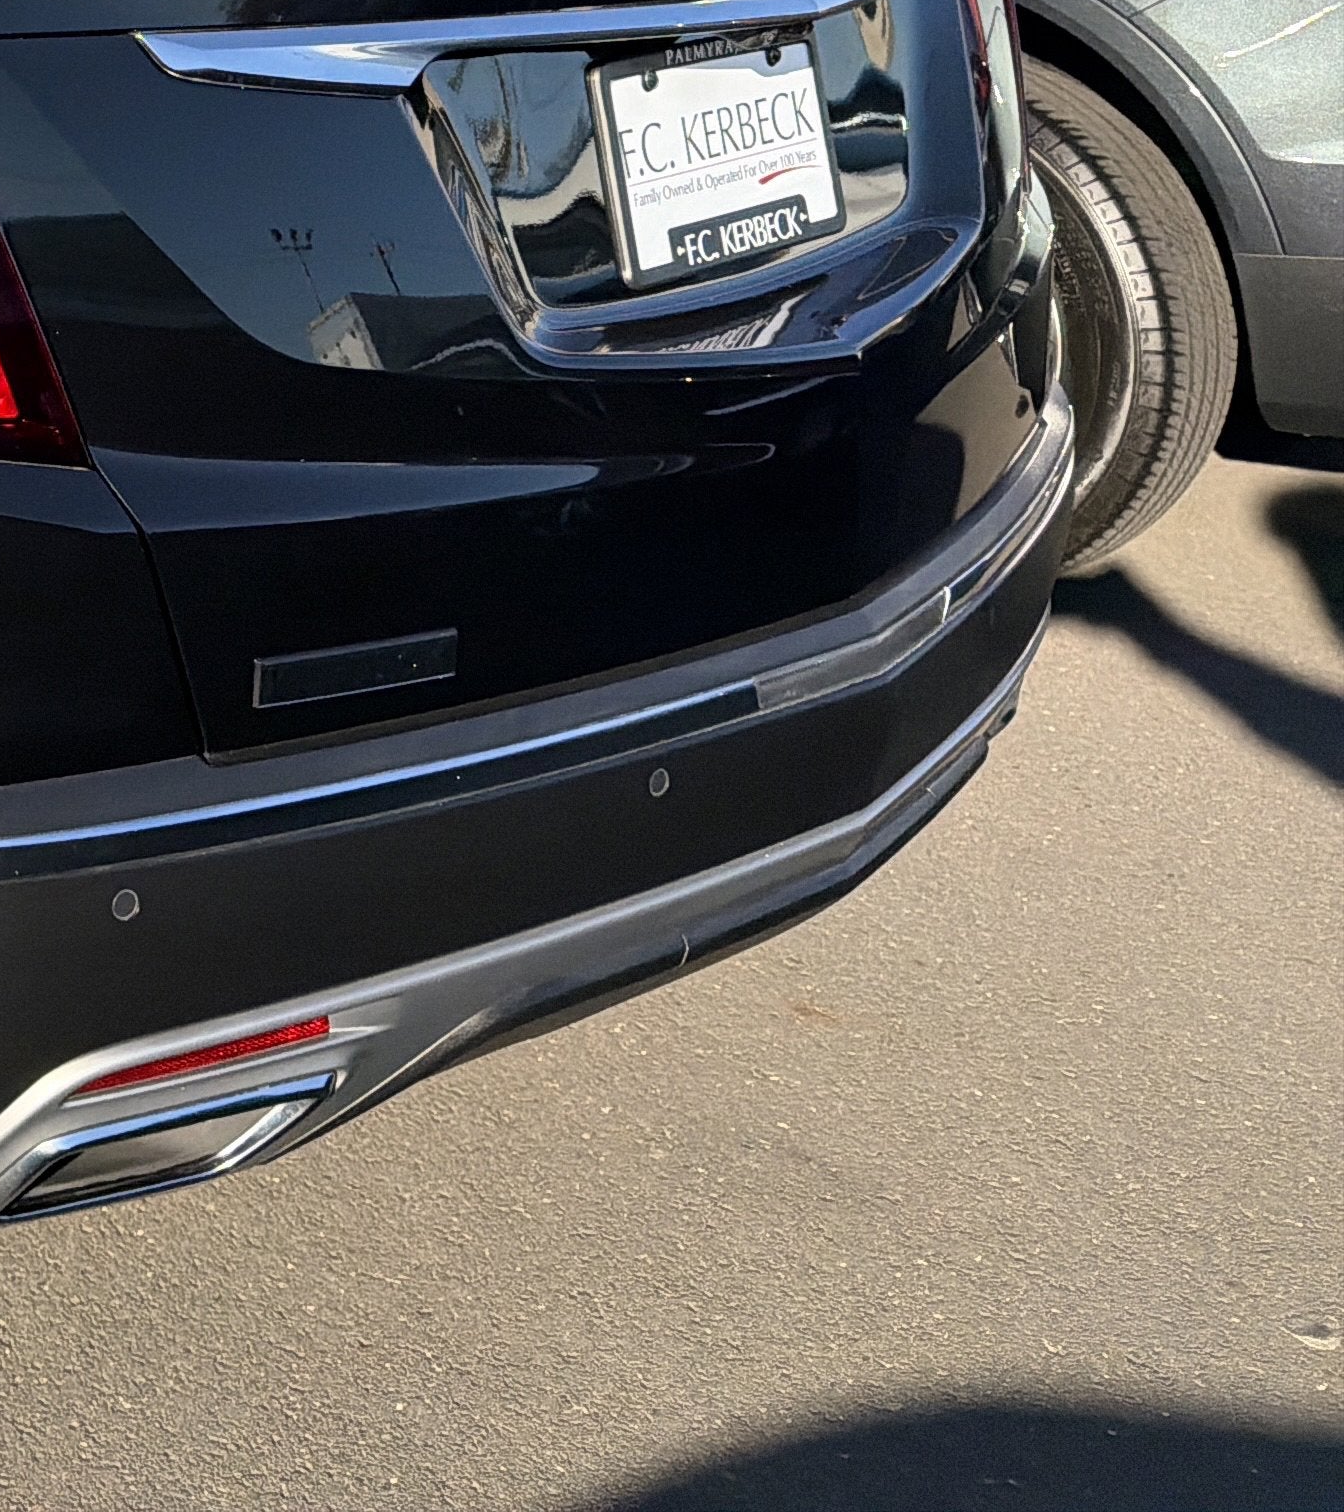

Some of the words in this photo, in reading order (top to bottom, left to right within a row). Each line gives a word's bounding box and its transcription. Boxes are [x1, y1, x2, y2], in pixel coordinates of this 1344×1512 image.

[617, 121, 676, 179] F.C.
[680, 87, 816, 165] KERBECK
[633, 186, 662, 208] Family
[662, 178, 695, 200] Owned
[696, 176, 704, 191] &
[704, 167, 744, 190] Operated
[744, 164, 758, 180] For
[758, 159, 779, 174] Over
[779, 153, 795, 168] 100
[794, 149, 818, 164] Years
[683, 229, 720, 266] F.C.
[719, 205, 803, 257] KERBECK
